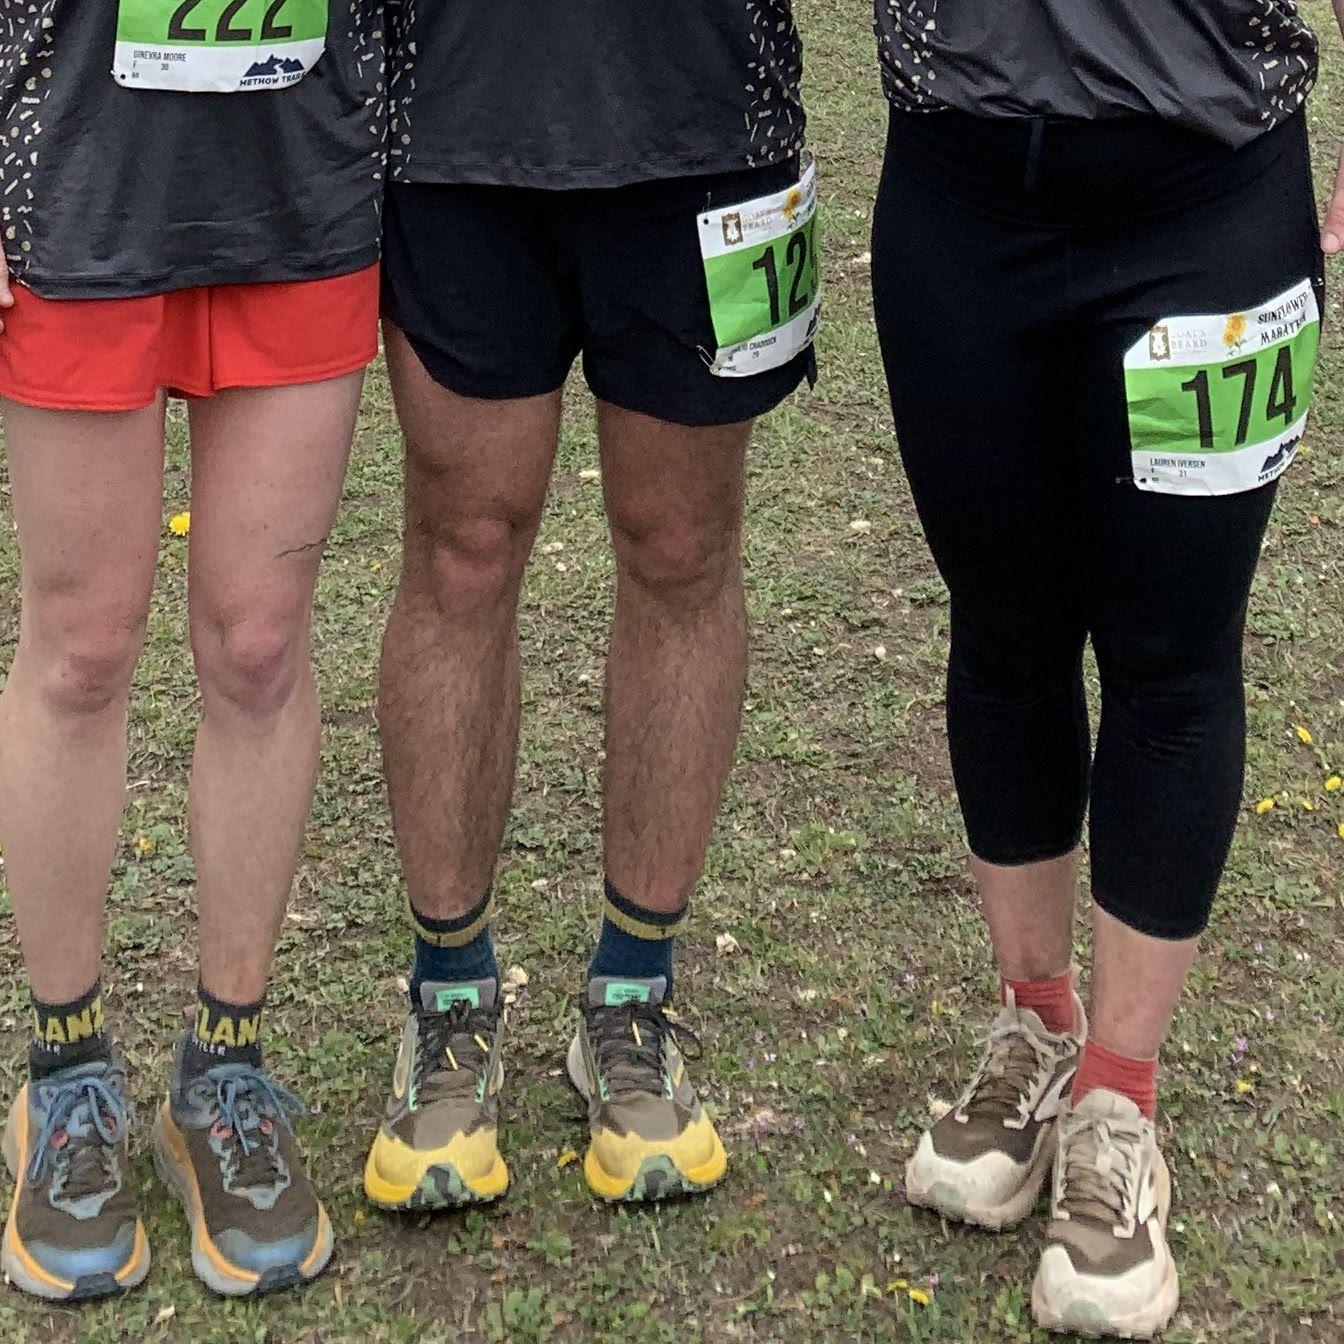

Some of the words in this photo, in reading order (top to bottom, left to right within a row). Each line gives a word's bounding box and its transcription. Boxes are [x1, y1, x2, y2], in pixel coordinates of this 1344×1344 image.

[239, 77, 279, 86] METHOW
[752, 216, 816, 327] 12
[1181, 344, 1297, 449] 174
